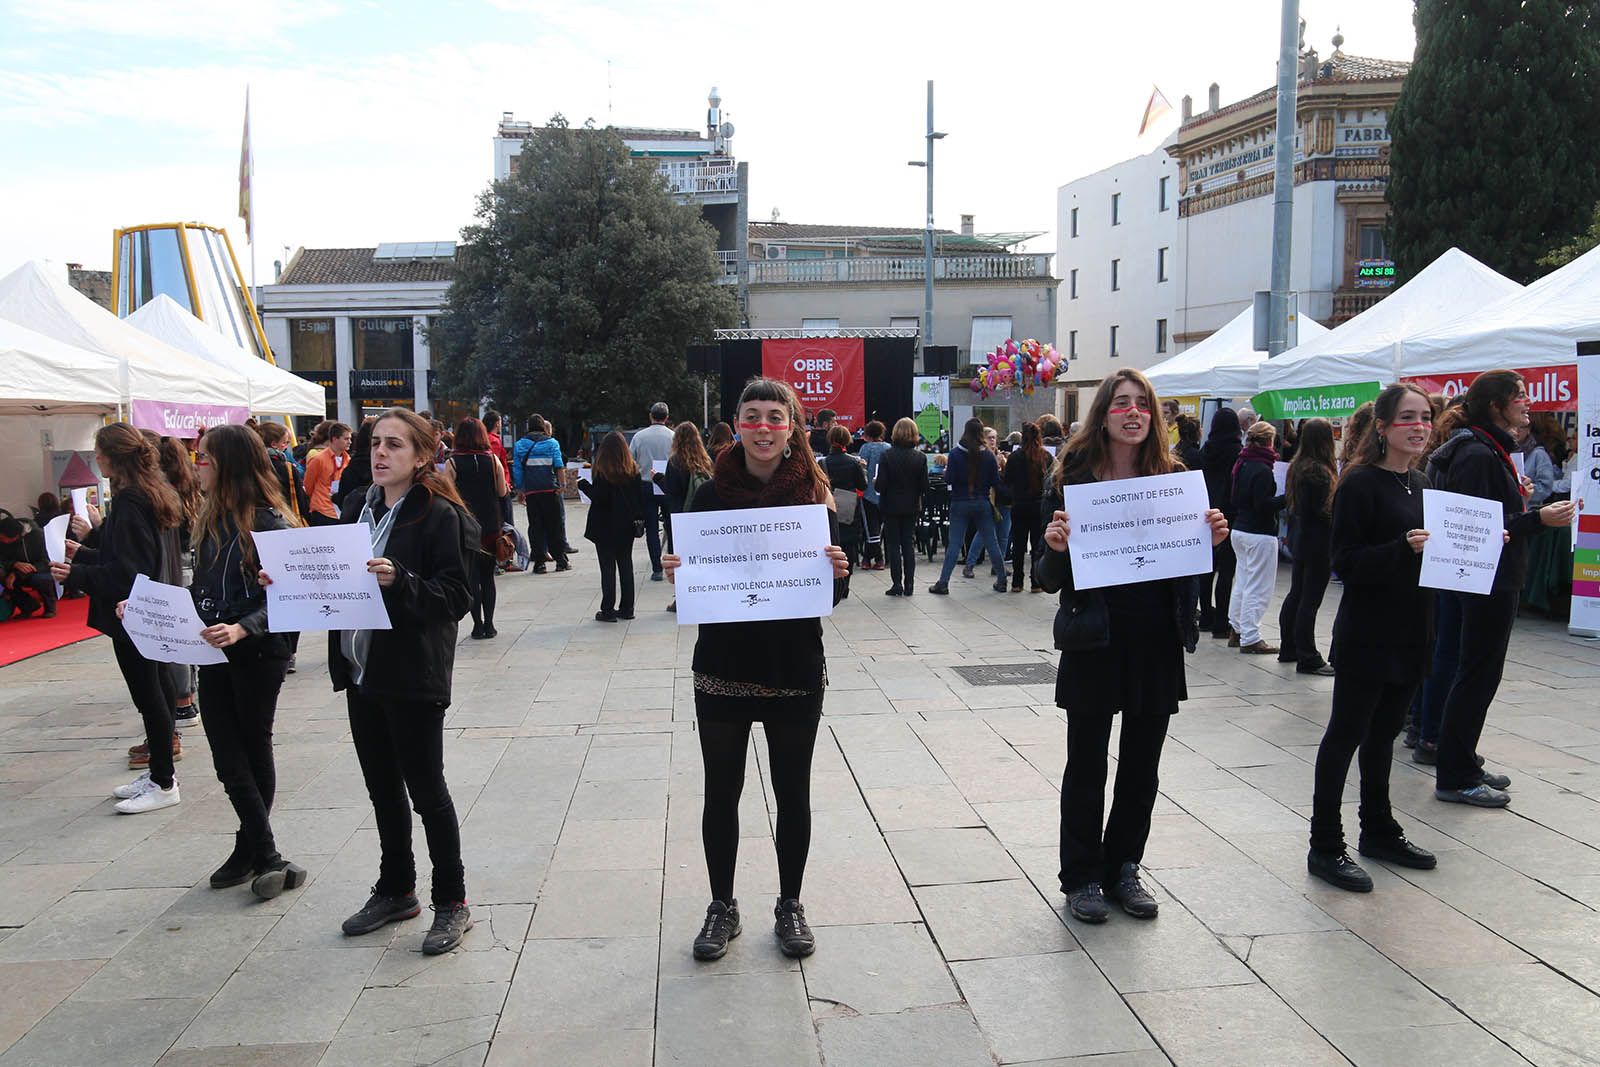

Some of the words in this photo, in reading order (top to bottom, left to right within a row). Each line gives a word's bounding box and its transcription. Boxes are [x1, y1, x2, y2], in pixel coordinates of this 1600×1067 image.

[1344, 128, 1392, 143] FABRI
[358, 319, 409, 331] Cultural
[793, 359, 833, 372] OBRE
[360, 378, 388, 387] Abacus
[1528, 373, 1571, 403] ulls
[1283, 395, 1318, 415] Implica't,
[1319, 394, 1330, 410] fes
[1330, 396, 1356, 409] xarxa
[1092, 498, 1109, 506] QUAN
[1110, 492, 1144, 503] SORTINT
[1146, 490, 1157, 499] DE
[1159, 487, 1184, 497] FESTA
[700, 528, 719, 537] QUAN
[719, 524, 758, 535] SORTINT
[760, 523, 772, 532] DE
[774, 521, 802, 532] FESTA
[1080, 520, 1135, 533] M'insisteixes
[1141, 518, 1155, 527] em
[1156, 512, 1198, 525] segueixes
[311, 546, 335, 554] CARRER
[1082, 552, 1098, 560] ESTIC
[1099, 549, 1119, 558] PATINT
[1159, 537, 1201, 550] MASCLISTA
[688, 552, 747, 565] M'insisteixes
[756, 553, 769, 561] em
[771, 549, 818, 562] segueixes
[285, 563, 297, 571] Em
[298, 562, 316, 571] mires
[331, 562, 338, 571] si
[339, 563, 350, 571] em
[688, 585, 708, 593] ESTIC
[708, 584, 730, 592] PATINT
[776, 578, 822, 588] MASCLISTA
[338, 592, 371, 600] MASCLISTA
